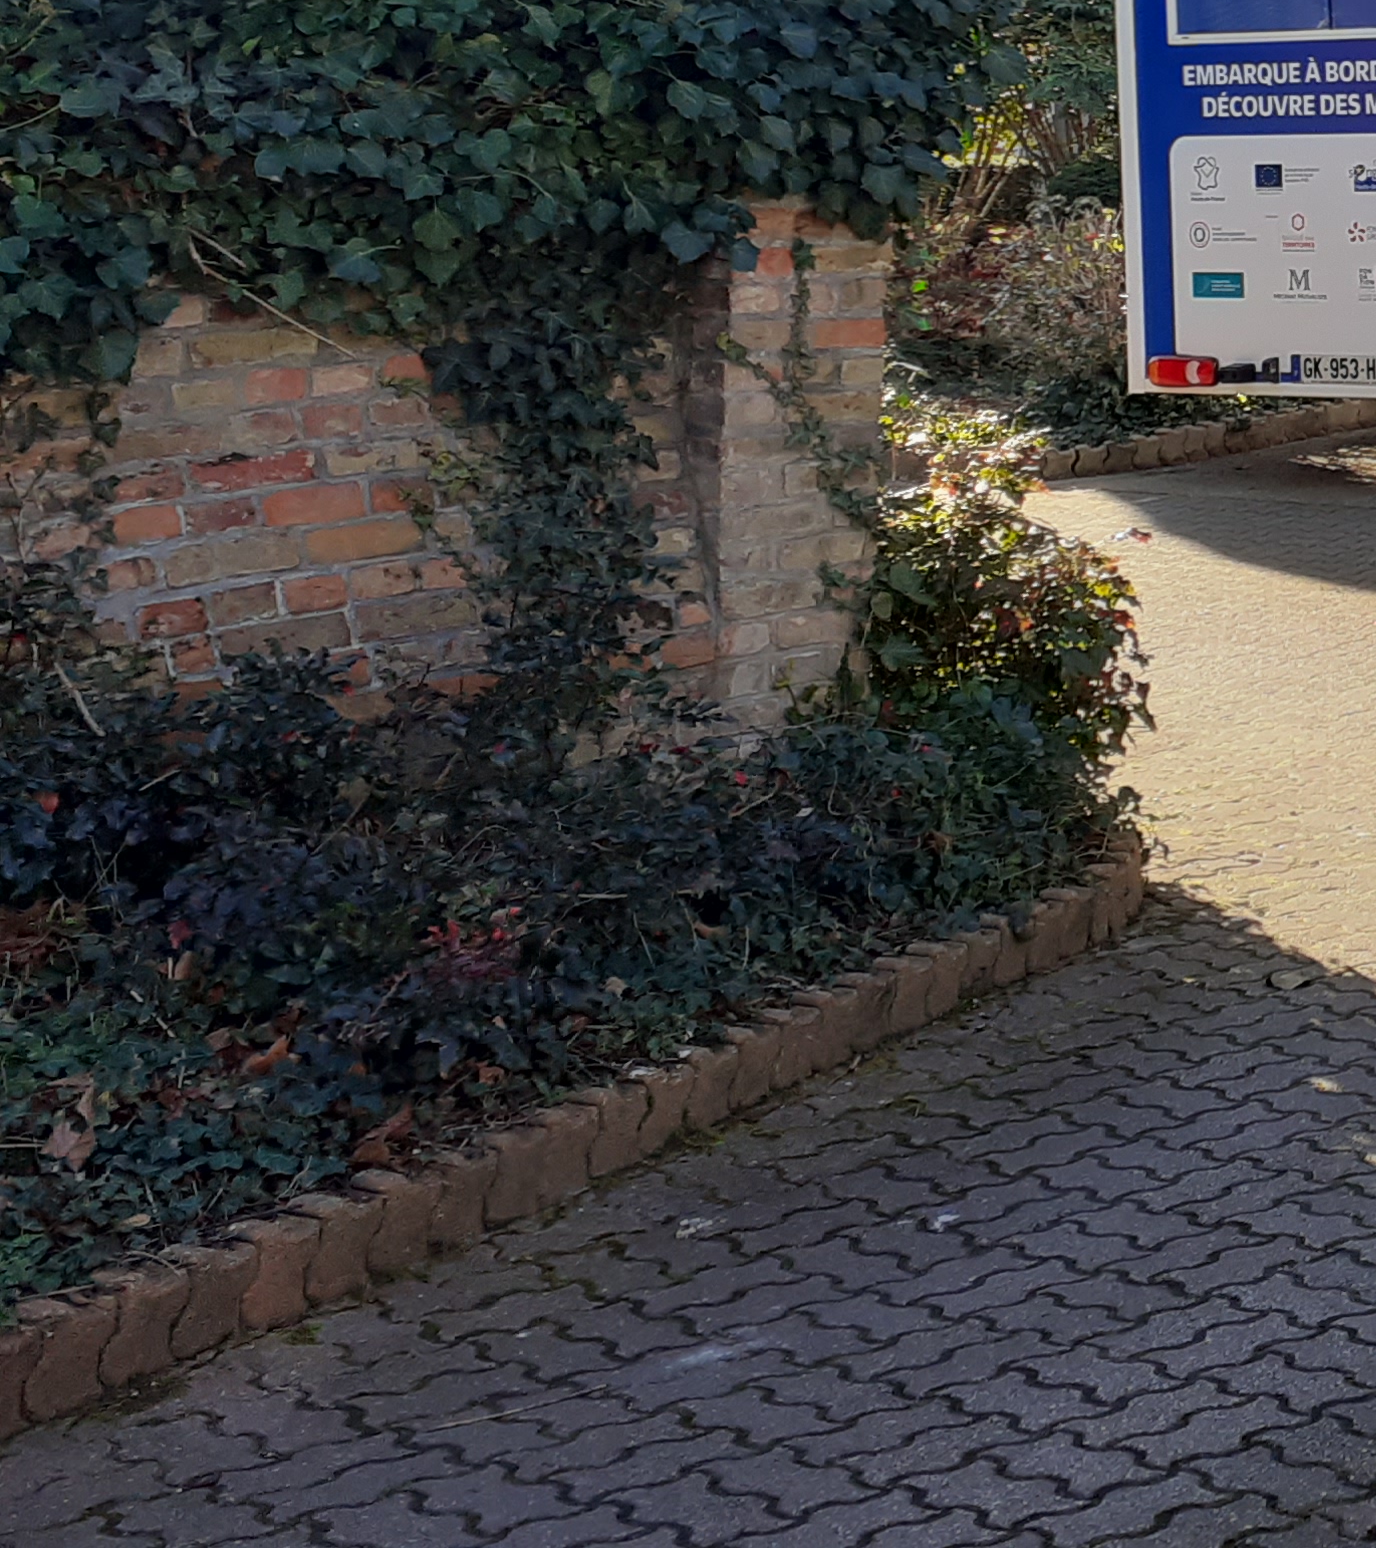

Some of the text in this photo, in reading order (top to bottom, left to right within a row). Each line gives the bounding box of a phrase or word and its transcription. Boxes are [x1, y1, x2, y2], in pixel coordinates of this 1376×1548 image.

[1182, 61, 1301, 87] EMBARQUE
[1304, 56, 1321, 84] À
[1202, 91, 1316, 118] DÉCOUVRE
[1319, 93, 1361, 116] DES
